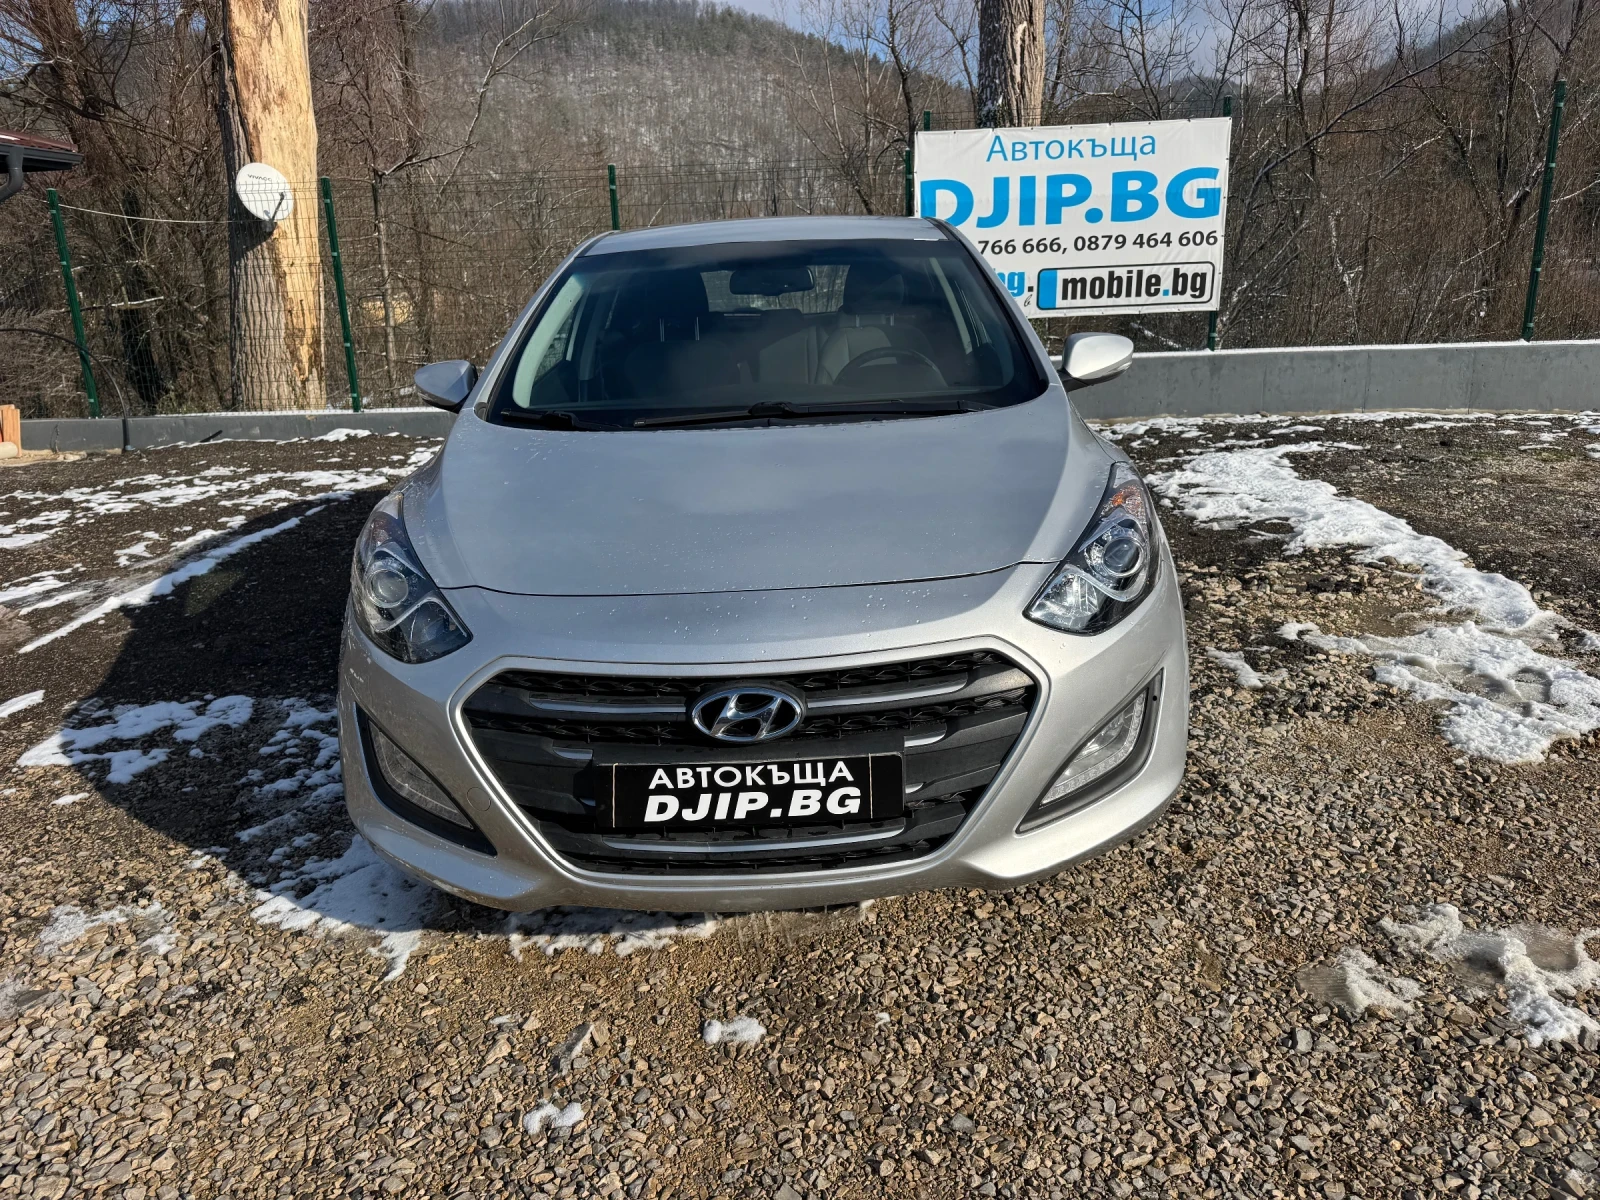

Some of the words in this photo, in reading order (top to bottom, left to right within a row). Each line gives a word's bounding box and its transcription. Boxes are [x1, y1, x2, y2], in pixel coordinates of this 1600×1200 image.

[986, 134, 1156, 162] Автокъща
[920, 167, 1221, 229] DJIP.BG
[978, 239, 1016, 255] 766
[1022, 236, 1068, 255] 666,
[1073, 235, 1126, 252] 0879
[1132, 232, 1172, 249] 464
[1179, 230, 1218, 247] 606
[1061, 267, 1207, 301] mobile.bg
[648, 761, 854, 790] АВТОКЪЩА
[643, 786, 861, 822] DJIP.BG
